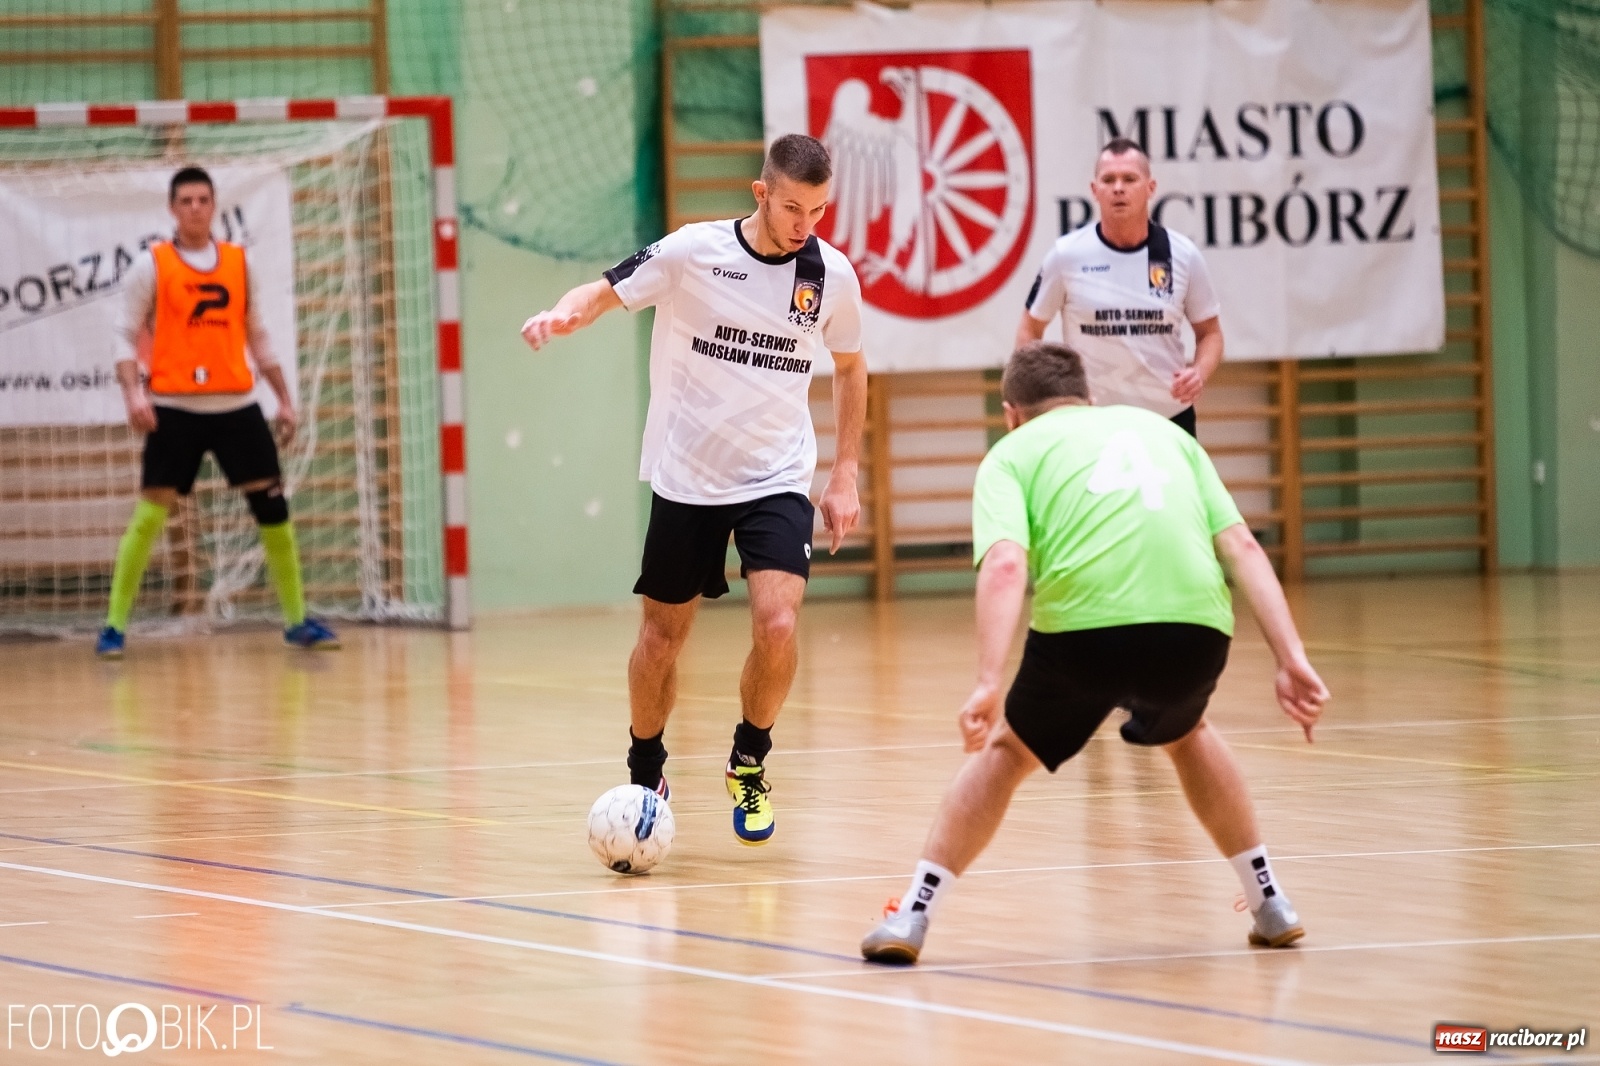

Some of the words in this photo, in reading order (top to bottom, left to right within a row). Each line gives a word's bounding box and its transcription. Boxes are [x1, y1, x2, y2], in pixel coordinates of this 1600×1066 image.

[1095, 102, 1364, 162] MIASTO
[1056, 173, 1415, 249] RCIBÓRZ
[722, 269, 748, 281] VIGO
[1095, 309, 1164, 321] AUTO-SERWIS
[691, 336, 751, 366] MIROSŁAW
[714, 325, 797, 353] AUTO-SERWIS
[1087, 430, 1173, 511] 4
